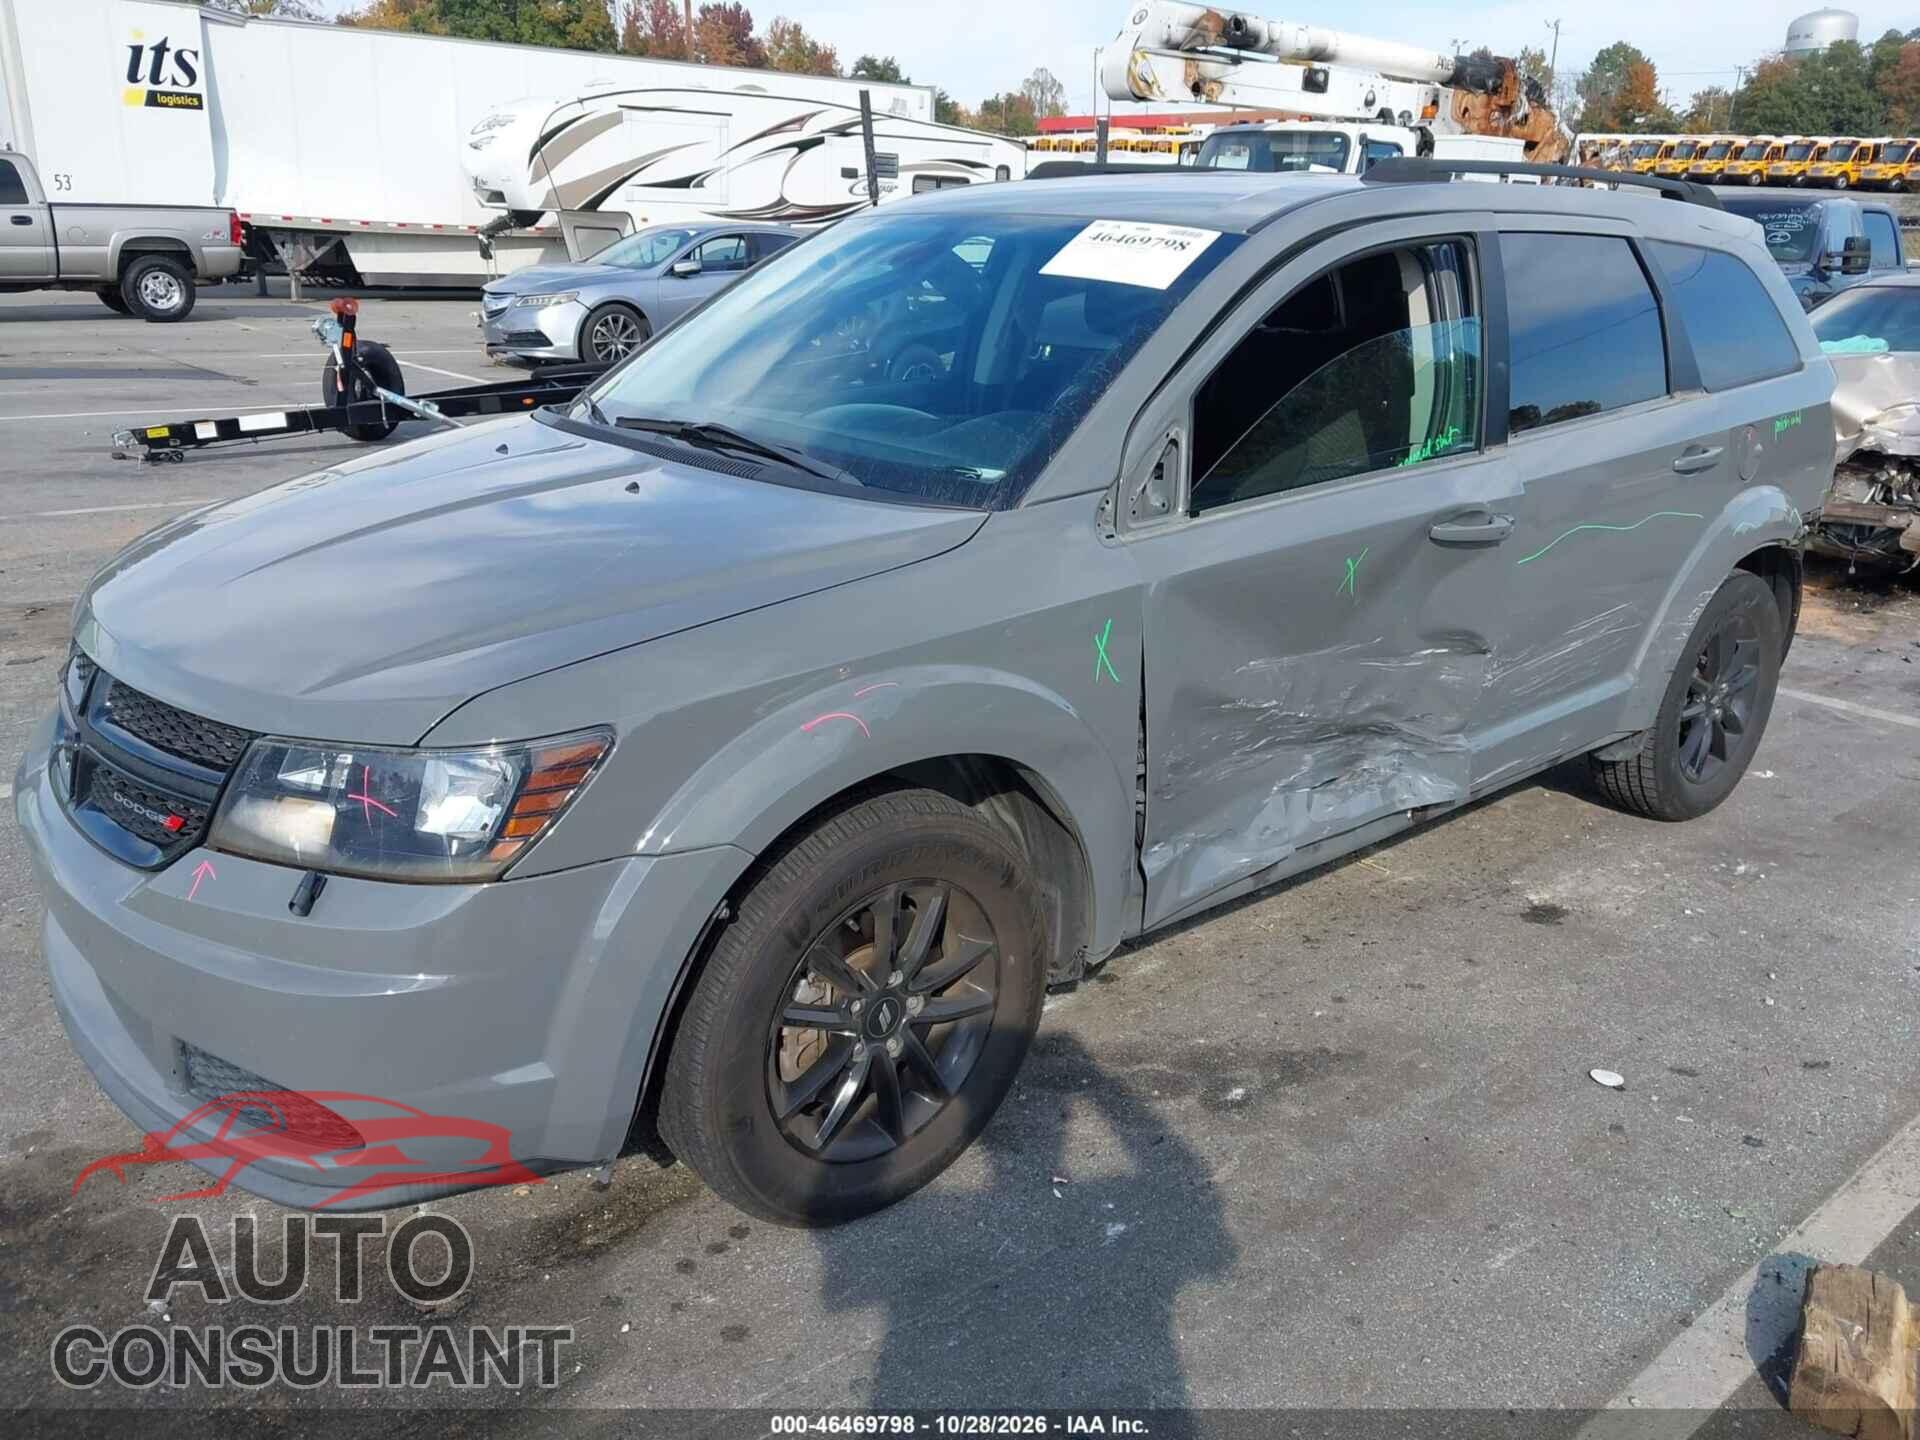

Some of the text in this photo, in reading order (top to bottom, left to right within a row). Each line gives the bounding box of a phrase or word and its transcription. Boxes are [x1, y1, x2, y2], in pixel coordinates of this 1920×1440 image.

[126, 28, 199, 88] its
[157, 93, 199, 106] logistics
[1089, 232, 1191, 252] 46469798
[113, 791, 169, 825] DODGE
